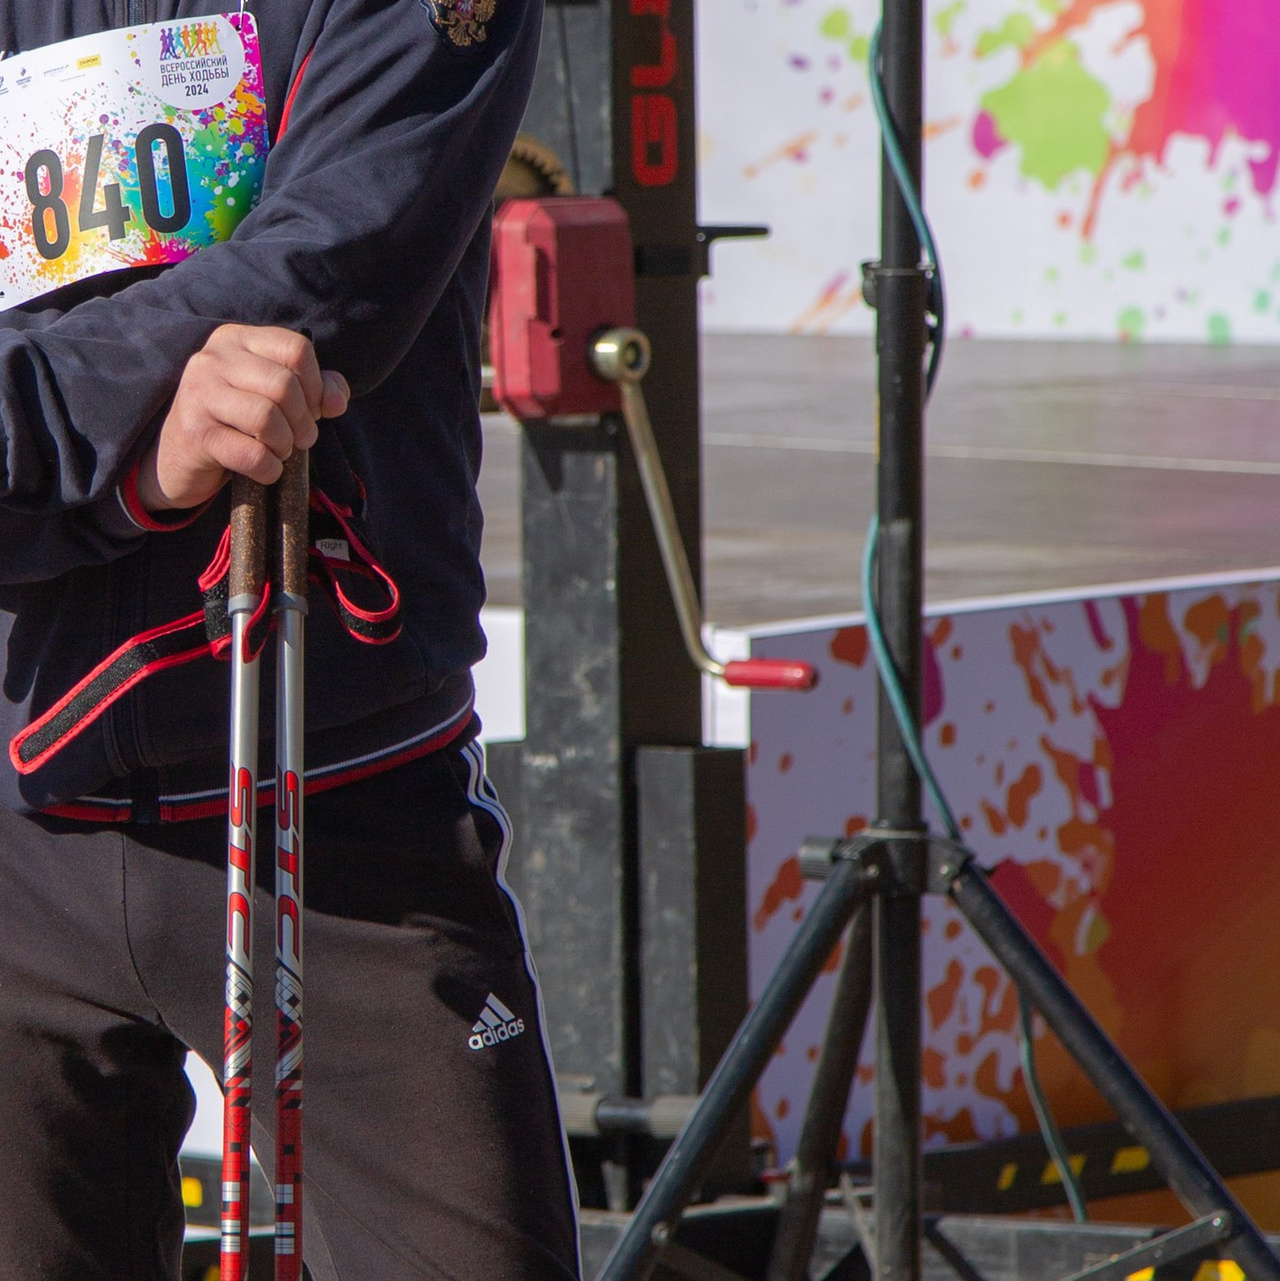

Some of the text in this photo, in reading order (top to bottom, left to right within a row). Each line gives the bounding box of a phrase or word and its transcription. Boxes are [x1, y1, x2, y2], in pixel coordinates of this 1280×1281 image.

[160, 55, 228, 74] ВСЕРОССИЙСКИЙ
[161, 67, 229, 87] ДЕНЬ ХОДЬБЫ
[185, 83, 209, 97] 2024
[25, 122, 192, 261] 840
[229, 762, 252, 961] STC
[277, 764, 300, 964] STC
[468, 1018, 525, 1051] adidas
